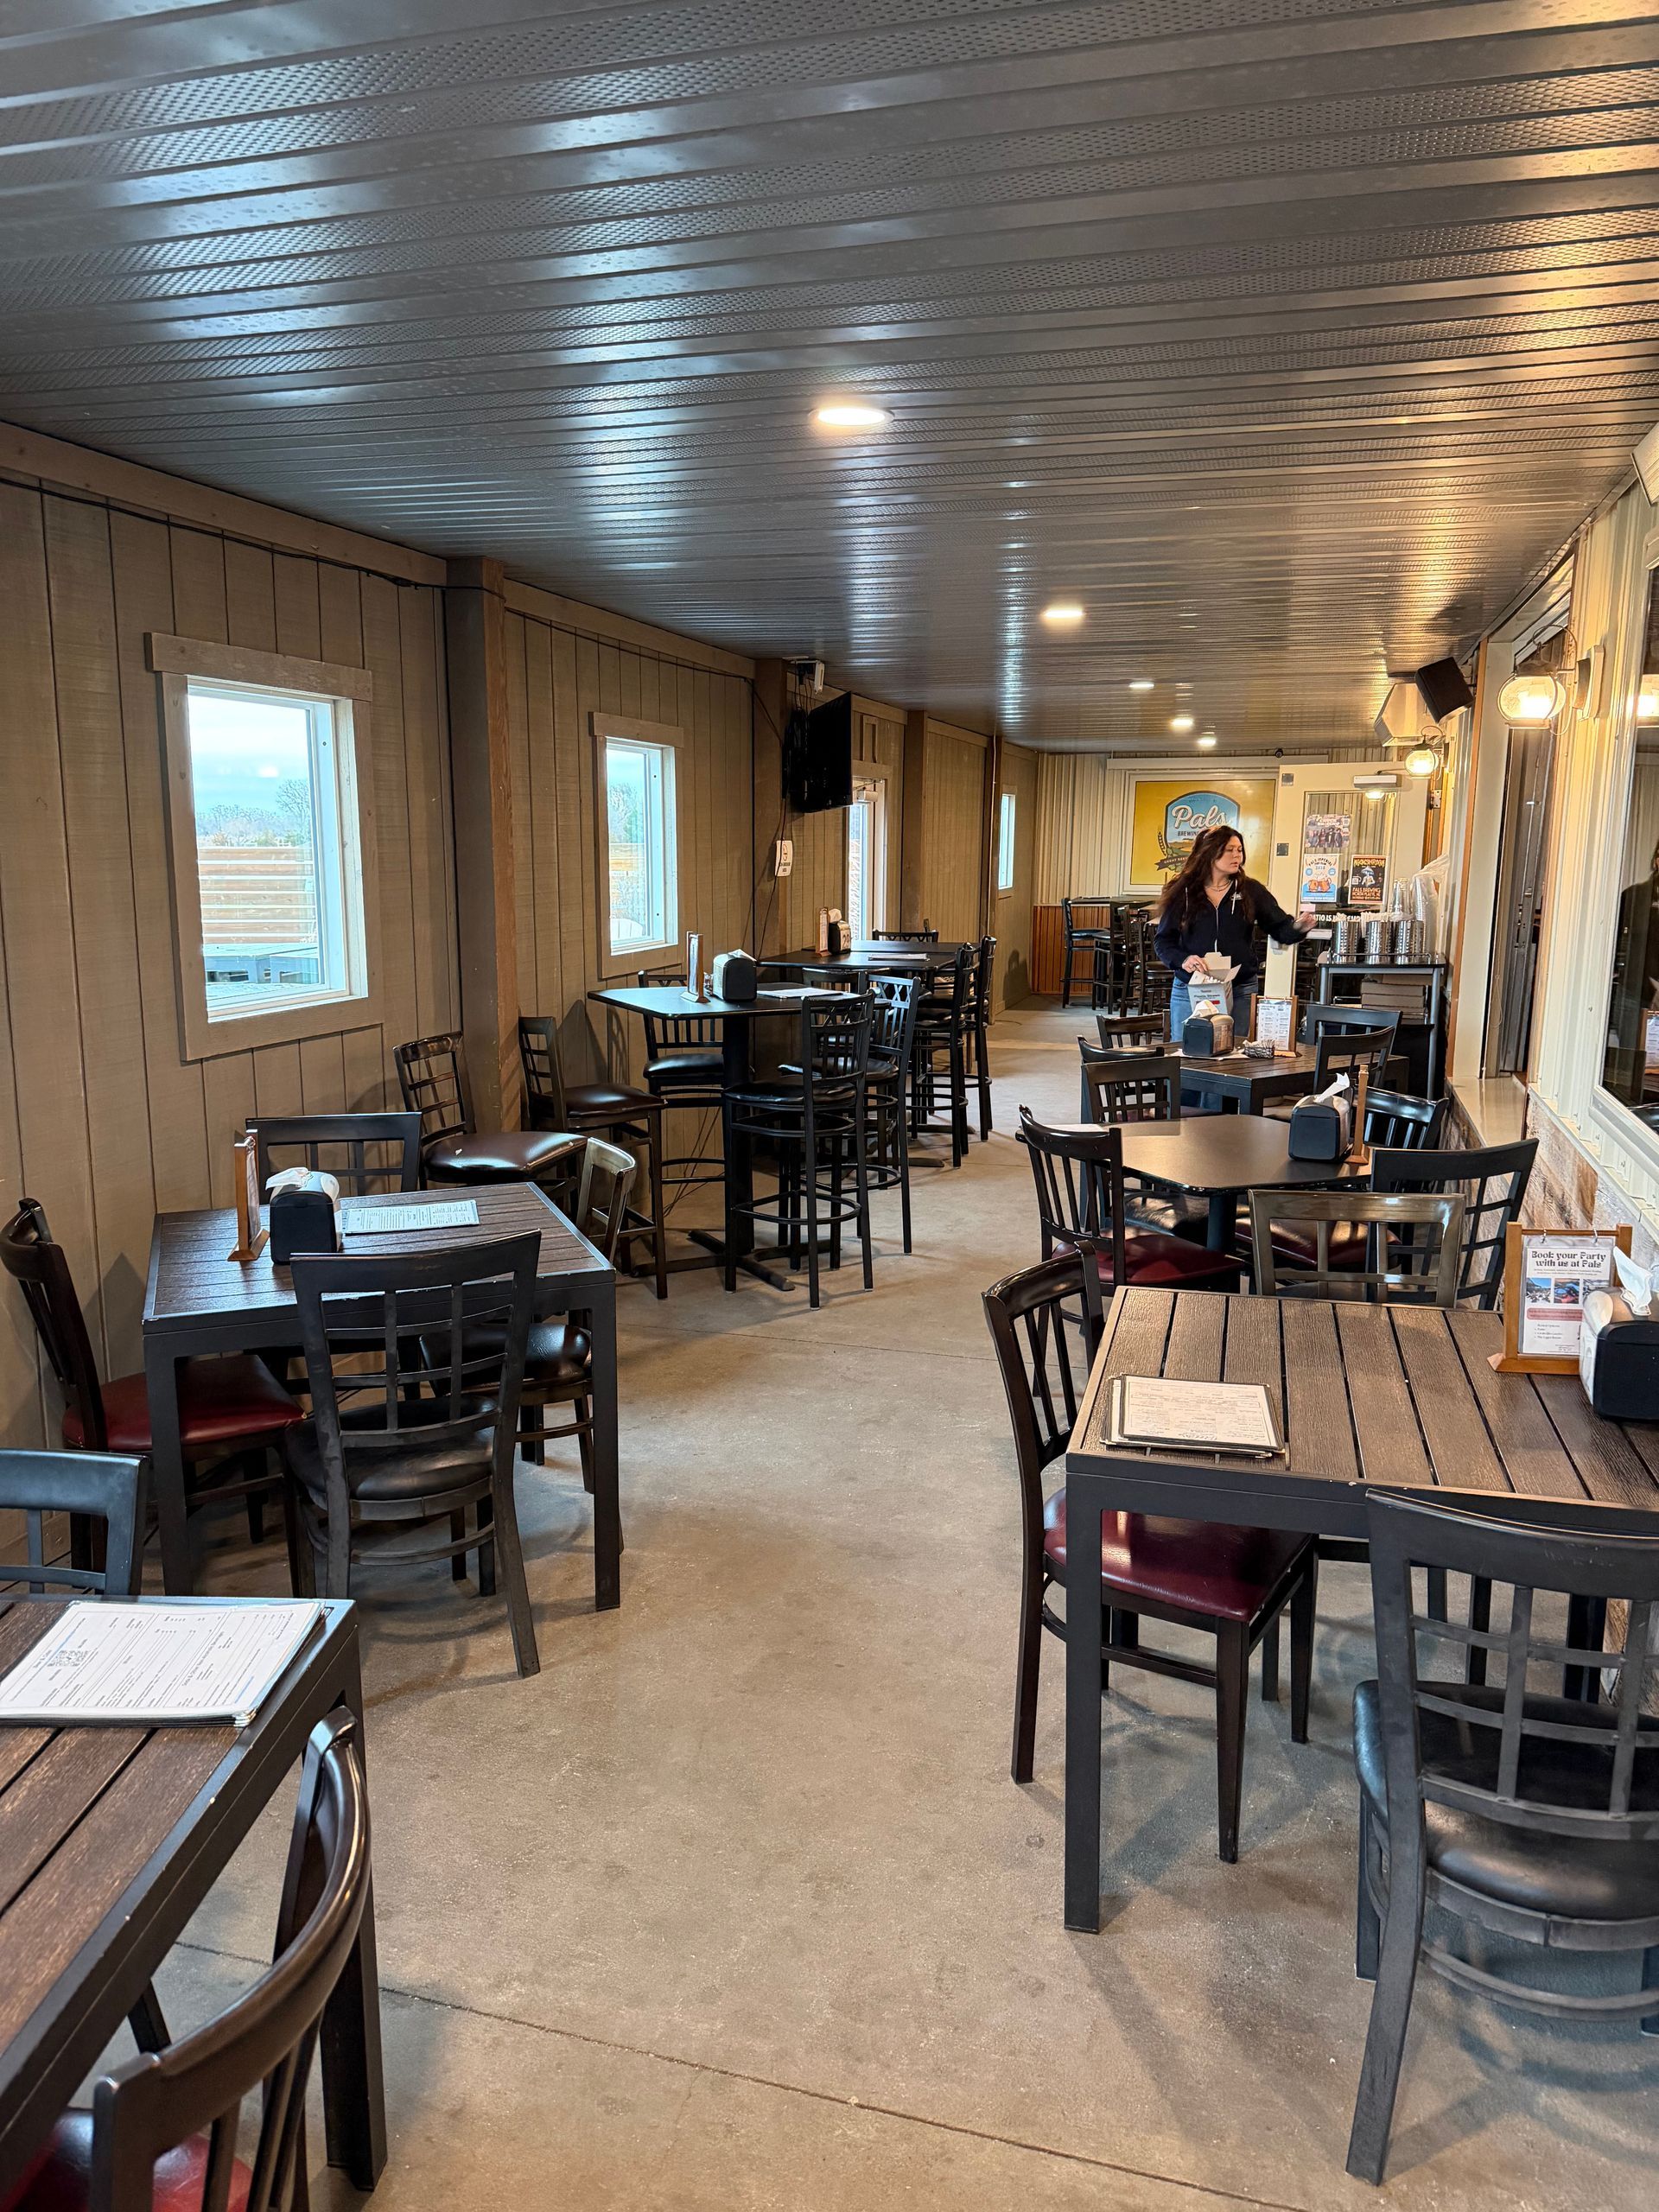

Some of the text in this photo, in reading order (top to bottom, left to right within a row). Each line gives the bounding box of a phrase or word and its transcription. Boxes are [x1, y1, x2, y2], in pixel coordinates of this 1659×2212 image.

[1172, 804, 1231, 829] Pals
[1556, 1252, 1578, 1261] your
[1580, 1251, 1606, 1262] Party
